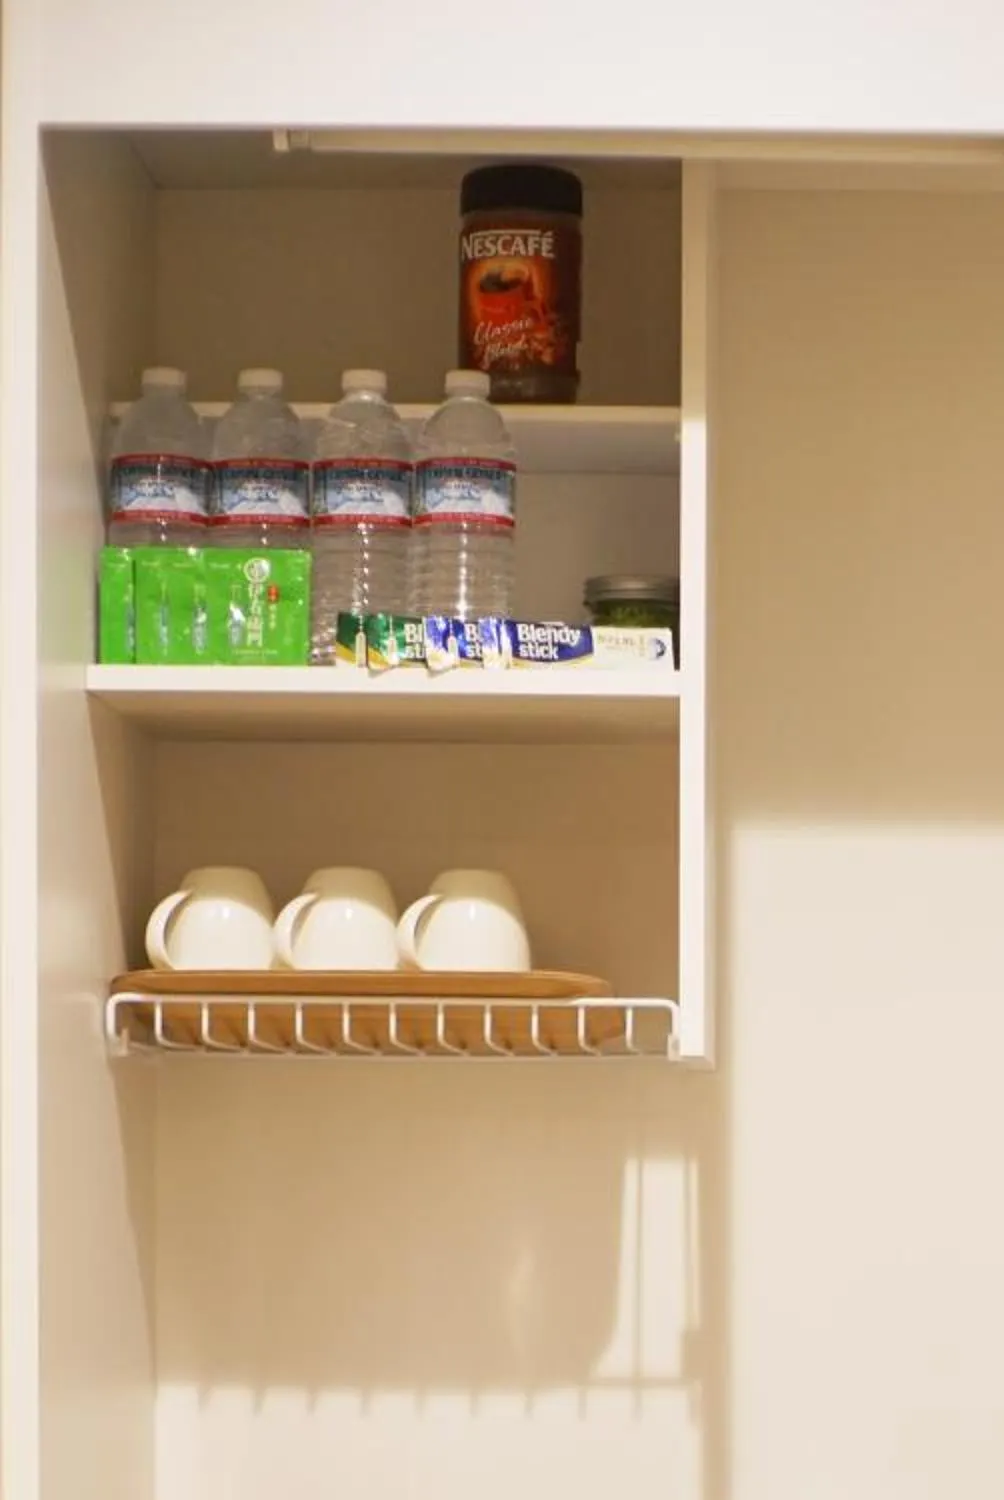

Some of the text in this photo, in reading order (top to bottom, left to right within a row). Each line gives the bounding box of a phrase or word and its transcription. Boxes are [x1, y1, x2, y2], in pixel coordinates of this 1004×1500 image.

[461, 229, 555, 261] NESCAFÉ
[516, 623, 581, 647] Blendy
[519, 639, 559, 660] stick
